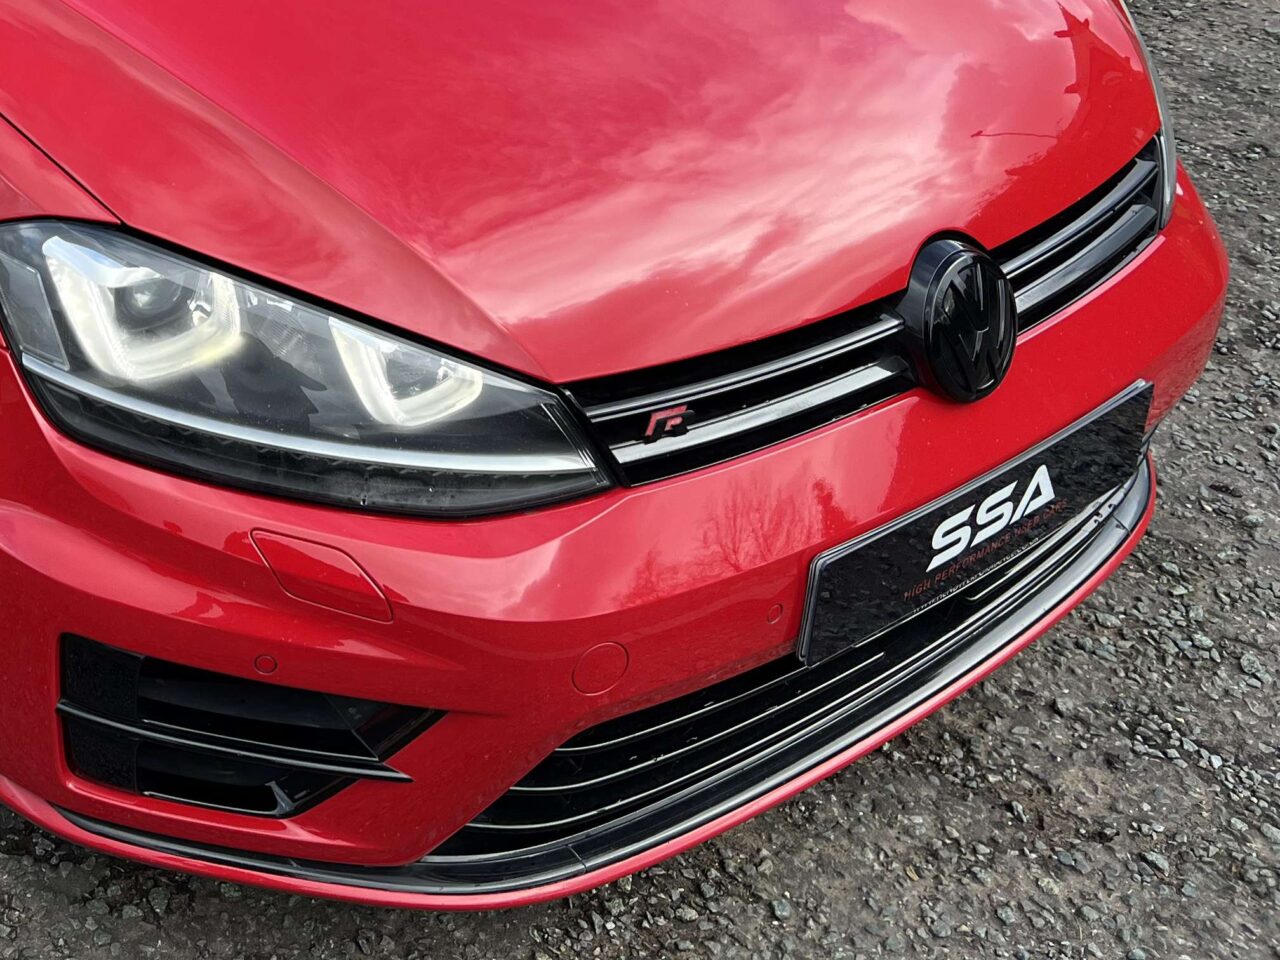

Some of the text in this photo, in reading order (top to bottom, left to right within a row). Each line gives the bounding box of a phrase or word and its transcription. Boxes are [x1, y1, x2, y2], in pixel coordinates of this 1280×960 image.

[925, 464, 1056, 573] SSA
[902, 578, 931, 601] HIGH
[934, 532, 1012, 583] PERFORMANCE
